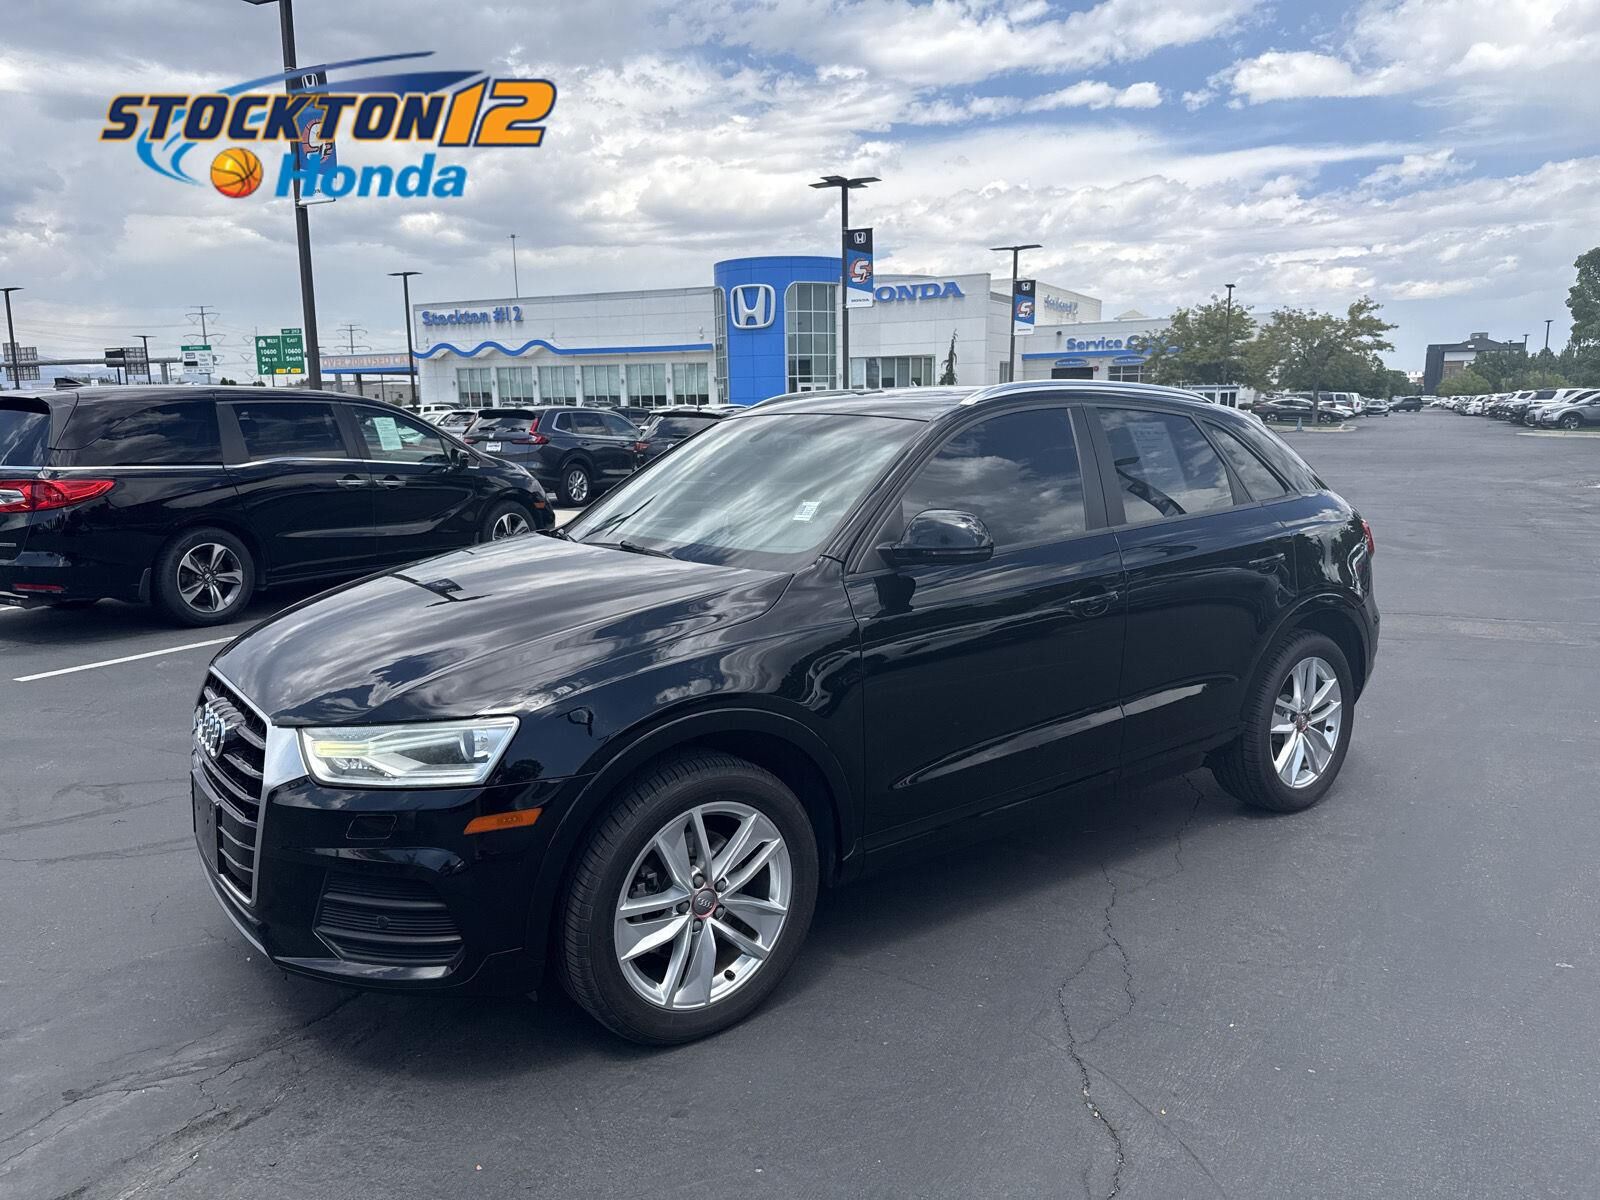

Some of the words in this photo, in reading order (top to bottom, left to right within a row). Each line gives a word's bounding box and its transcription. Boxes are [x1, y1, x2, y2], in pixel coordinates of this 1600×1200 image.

[873, 281, 965, 302] ONDA
[422, 310, 490, 326] Stockton
[492, 305, 524, 323] #12
[1067, 337, 1122, 350] Service
[322, 359, 345, 367] OVER
[367, 357, 390, 366] USED
